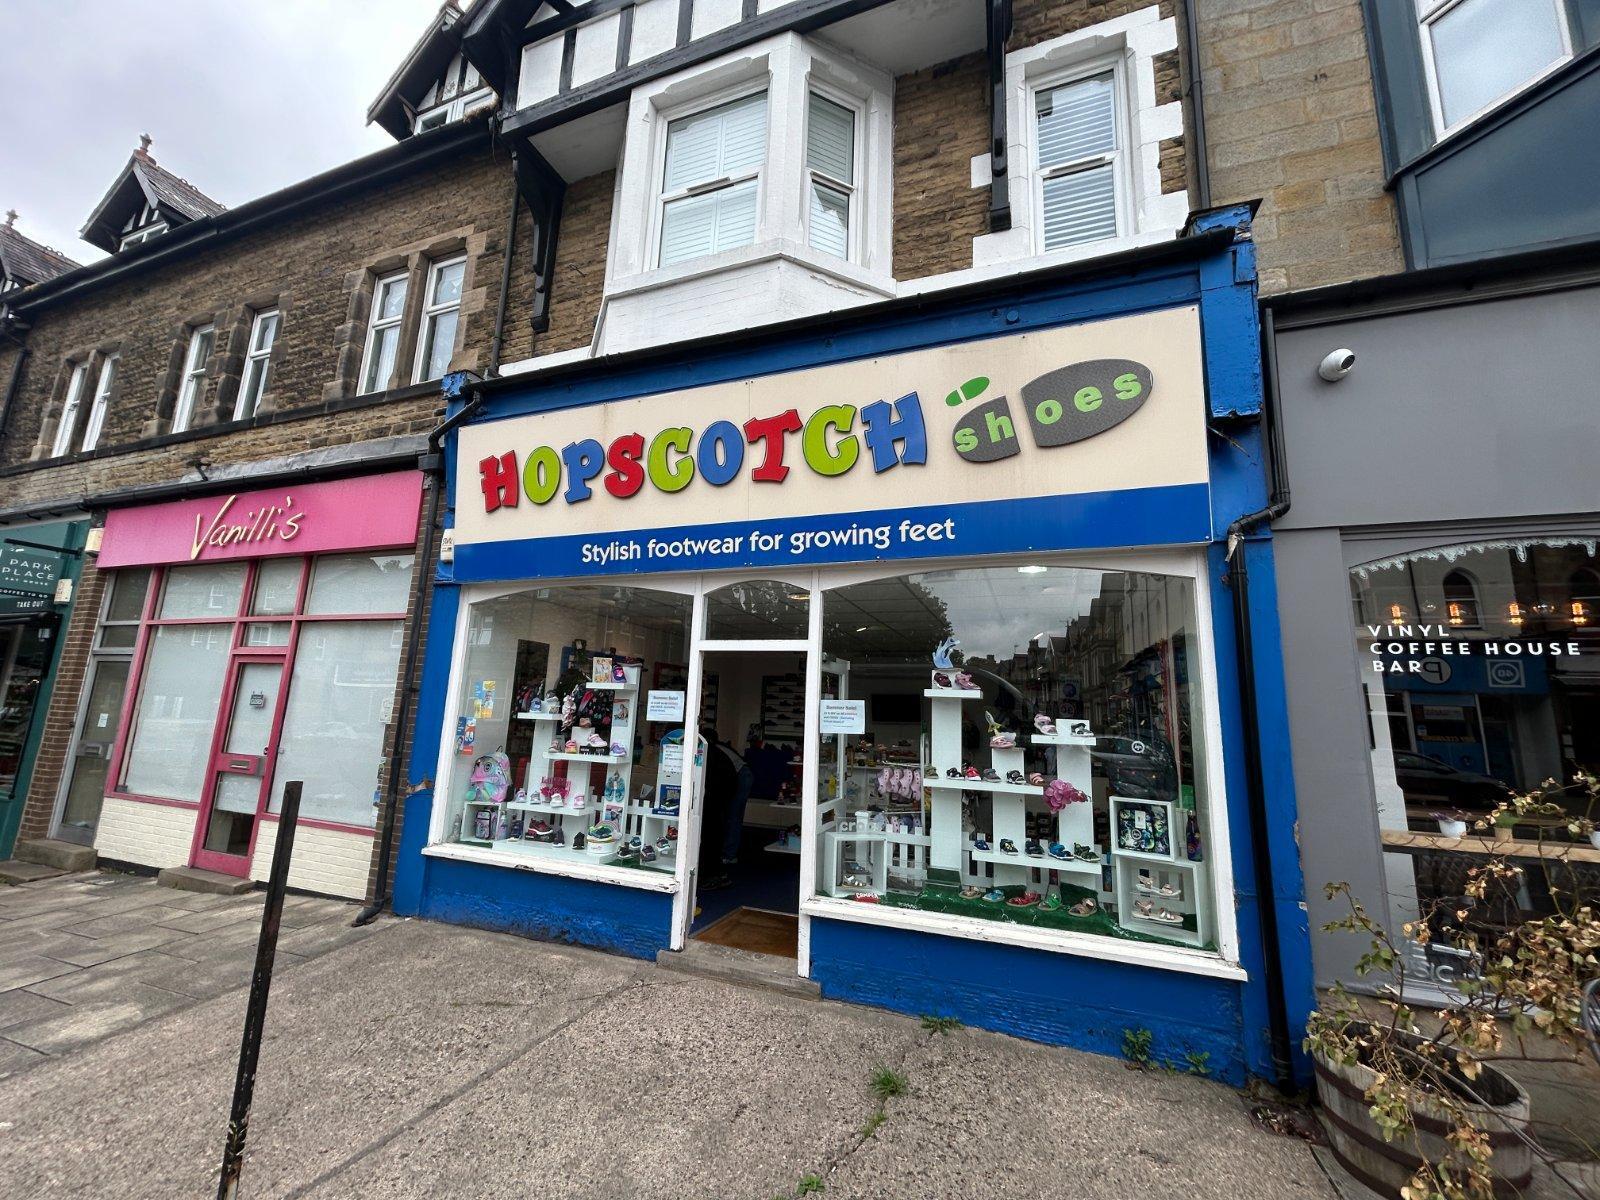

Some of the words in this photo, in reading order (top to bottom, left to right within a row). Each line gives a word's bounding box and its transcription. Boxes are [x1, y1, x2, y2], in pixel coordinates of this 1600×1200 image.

[954, 373, 1142, 453] shoes
[479, 391, 928, 514] HOPSCOTCH
[191, 495, 304, 560] Vanilli's
[581, 541, 642, 565] Stylish
[646, 536, 743, 559] footwear
[749, 531, 783, 552] for
[789, 523, 891, 554] growing
[899, 518, 956, 542] feet
[10, 558, 52, 571] PARK
[2, 567, 54, 580] PLACE
[32, 600, 44, 608] OUT
[1367, 624, 1450, 637] VINYL
[1370, 642, 1471, 656] COFFEE
[1485, 642, 1581, 656] HOUSE
[1372, 660, 1422, 673] BAR
